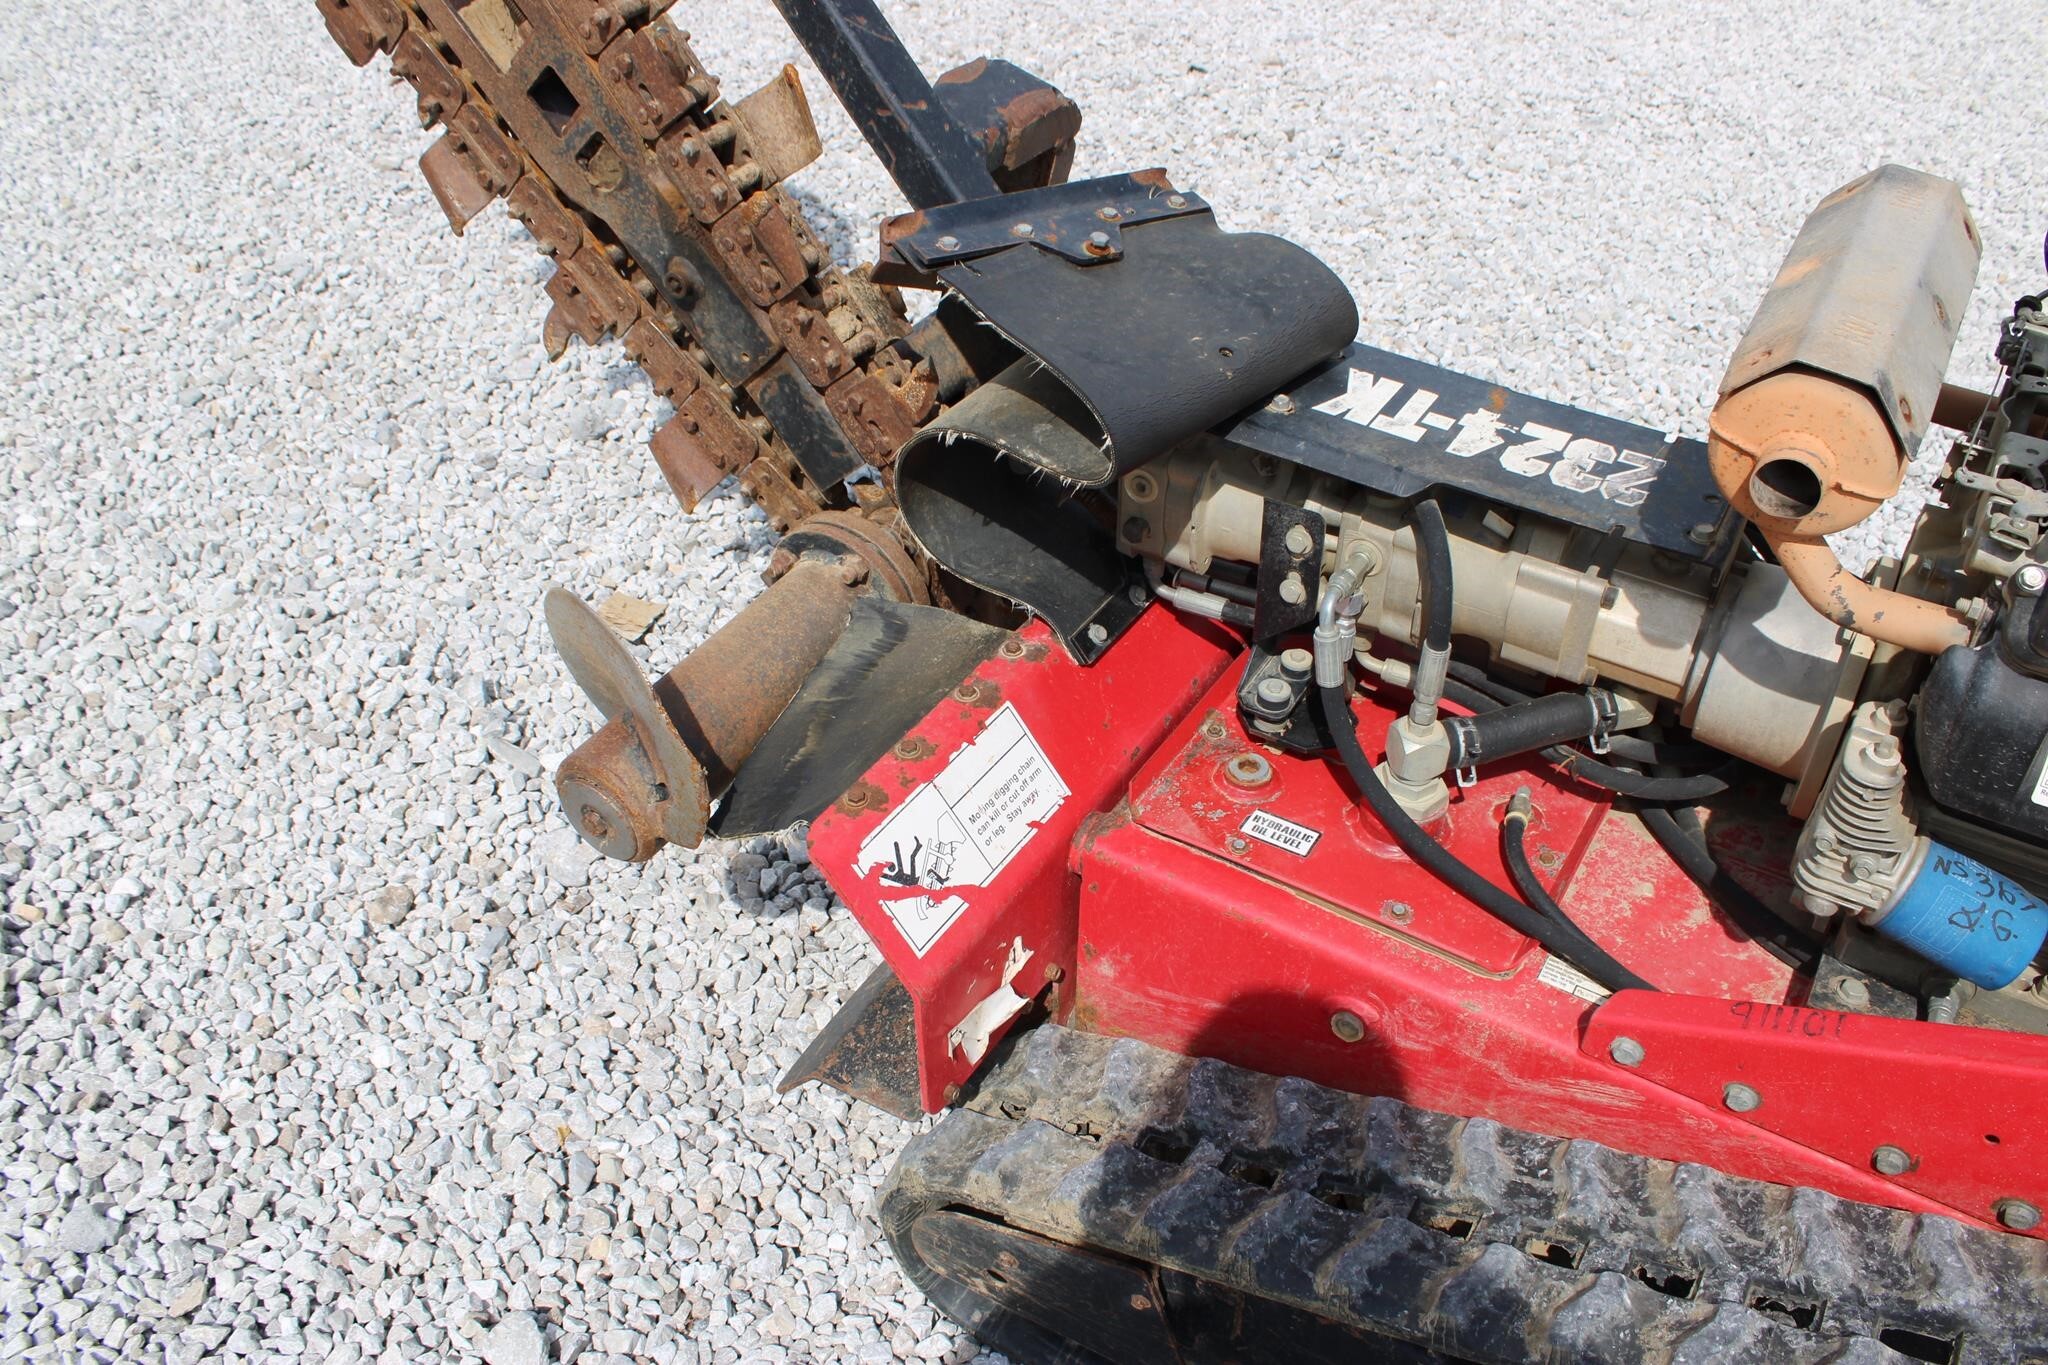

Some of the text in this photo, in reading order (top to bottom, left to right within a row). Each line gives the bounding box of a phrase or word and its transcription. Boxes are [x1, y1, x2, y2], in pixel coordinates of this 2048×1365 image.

[1311, 367, 1667, 506] 2324-TK
[993, 774, 1020, 800] digging
[1018, 755, 1036, 775] chain
[977, 767, 1042, 836] can kill or cut off arm
[984, 836, 993, 847] or
[992, 824, 1007, 838] leg.
[1006, 806, 1023, 823] Stay
[1251, 824, 1302, 849] OIL LEVEL
[1252, 814, 1314, 843] HYDRAULIC
